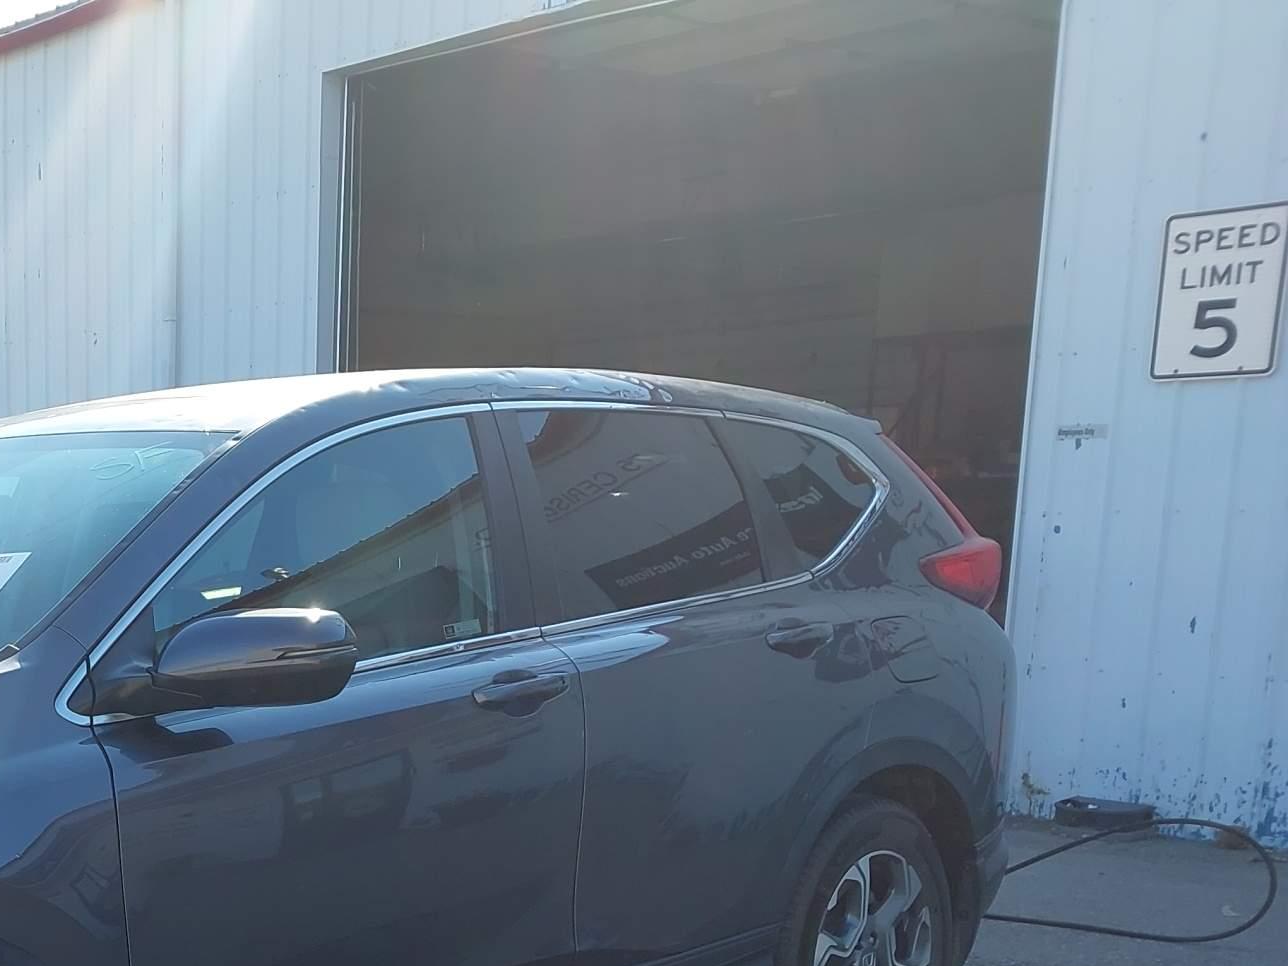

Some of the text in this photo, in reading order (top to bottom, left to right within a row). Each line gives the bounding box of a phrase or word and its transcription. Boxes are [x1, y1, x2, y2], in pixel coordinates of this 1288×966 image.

[1173, 221, 1281, 255] SPEED
[1180, 260, 1264, 290] LIMIT
[1189, 298, 1238, 359] 5
